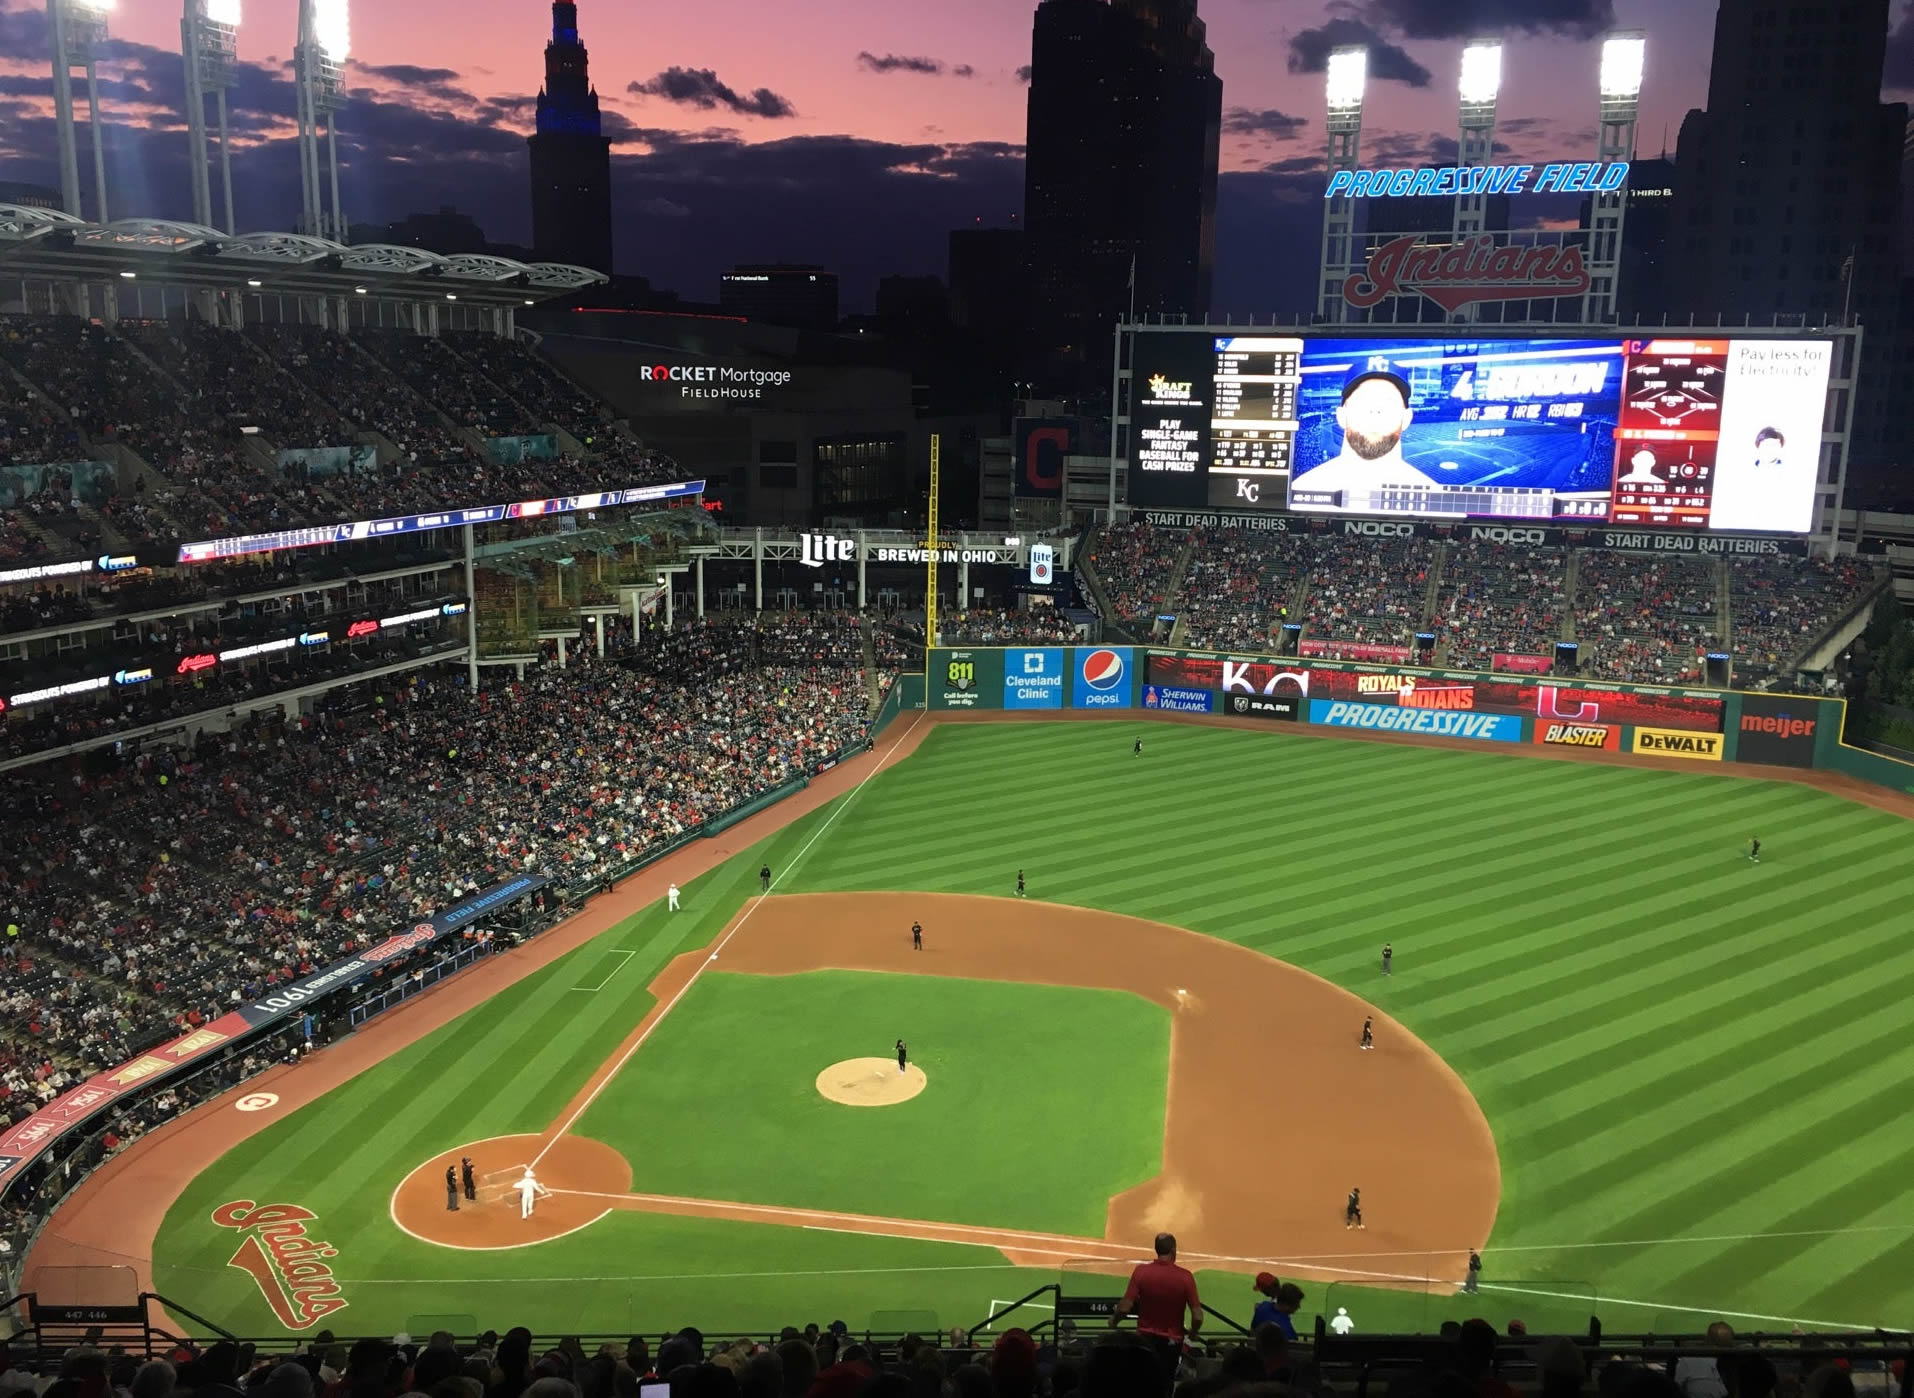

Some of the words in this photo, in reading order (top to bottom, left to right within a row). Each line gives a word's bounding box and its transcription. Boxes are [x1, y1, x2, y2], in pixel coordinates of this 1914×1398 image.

[1325, 165, 1533, 198] PROGRESSIVE
[1533, 162, 1630, 193] FIELD
[1343, 234, 1591, 311] Indians
[640, 365, 717, 381] ROCKET
[720, 367, 791, 386] Mortgage
[1151, 382, 1193, 392] DRAFT
[1451, 371, 1473, 400] 4
[1155, 391, 1190, 399] KINGS
[1460, 408, 1480, 421] AVG
[1512, 406, 1527, 419] HR
[1548, 404, 1565, 417] RBI
[1160, 420, 1181, 429] PLAY
[1141, 430, 1199, 440] SINGLE-GAME
[1151, 440, 1188, 450] FANTASY
[1027, 427, 1068, 489] C
[1139, 450, 1180, 460] BASEBALL
[1182, 451, 1199, 461] FOR
[1142, 461, 1164, 470] CASH
[1165, 462, 1195, 472] PRIZES
[1236, 478, 1260, 502] KC
[1145, 512, 1183, 526] START
[1185, 514, 1218, 527] DEAD
[1345, 521, 1414, 537] NOCO
[1471, 527, 1545, 544] NOCO
[800, 533, 854, 567] Lite
[918, 540, 957, 549] PROUDLY
[1605, 533, 1650, 548] START
[1654, 535, 1694, 551] DEAD
[1698, 537, 1779, 554] BATTERIES
[878, 549, 939, 563] BREWED
[943, 550, 959, 563] IN
[962, 550, 996, 563] OHIO
[1033, 551, 1052, 563] Lite
[42, 562, 81, 576] POWERED
[81, 560, 93, 571] BY
[177, 653, 216, 672] Indians
[948, 662, 973, 680] 811
[60, 678, 98, 694] POWERED
[99, 676, 110, 687] BY
[1006, 675, 1061, 687] Cleveland
[1358, 675, 1415, 692] ROYALS
[1017, 687, 1049, 699] Clinic
[1086, 693, 1119, 706] pepsi
[1161, 688, 1206, 701] SHERWIN
[1399, 690, 1473, 709] INDIANS
[1251, 702, 1290, 713] RAM
[1324, 703, 1500, 738] PROGRESSIVE
[1741, 713, 1816, 739] meijer
[1545, 725, 1607, 747] BLASTER
[444, 903, 475, 923] FIELD
[359, 923, 436, 961] Indians
[254, 987, 315, 1013] 1901
[74, 1089, 105, 1109] 1954
[18, 1120, 55, 1141] 1995
[211, 1199, 350, 1330] Indians
[1090, 1303, 1108, 1312] 446
